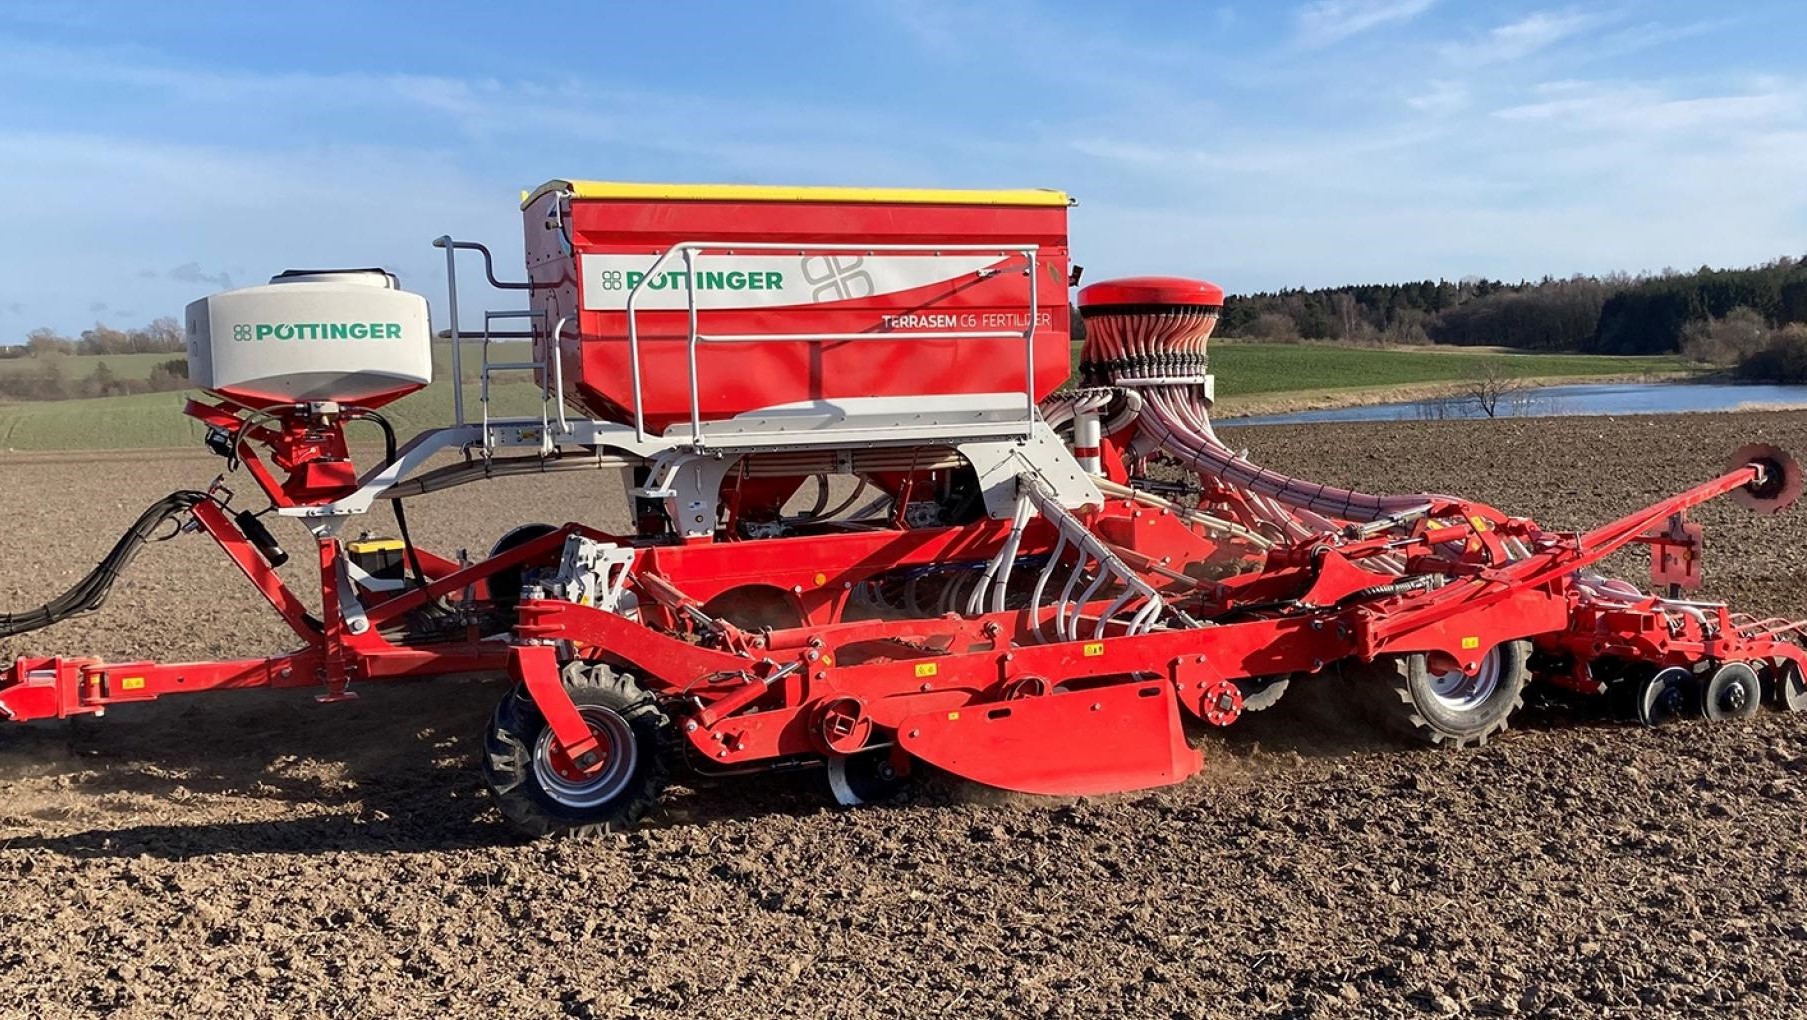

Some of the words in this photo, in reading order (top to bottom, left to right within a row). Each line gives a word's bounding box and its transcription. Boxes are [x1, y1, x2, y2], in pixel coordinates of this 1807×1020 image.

[881, 314, 957, 329] TERRASEM
[960, 313, 977, 328] C6
[255, 323, 402, 341] PÖTTINGER
